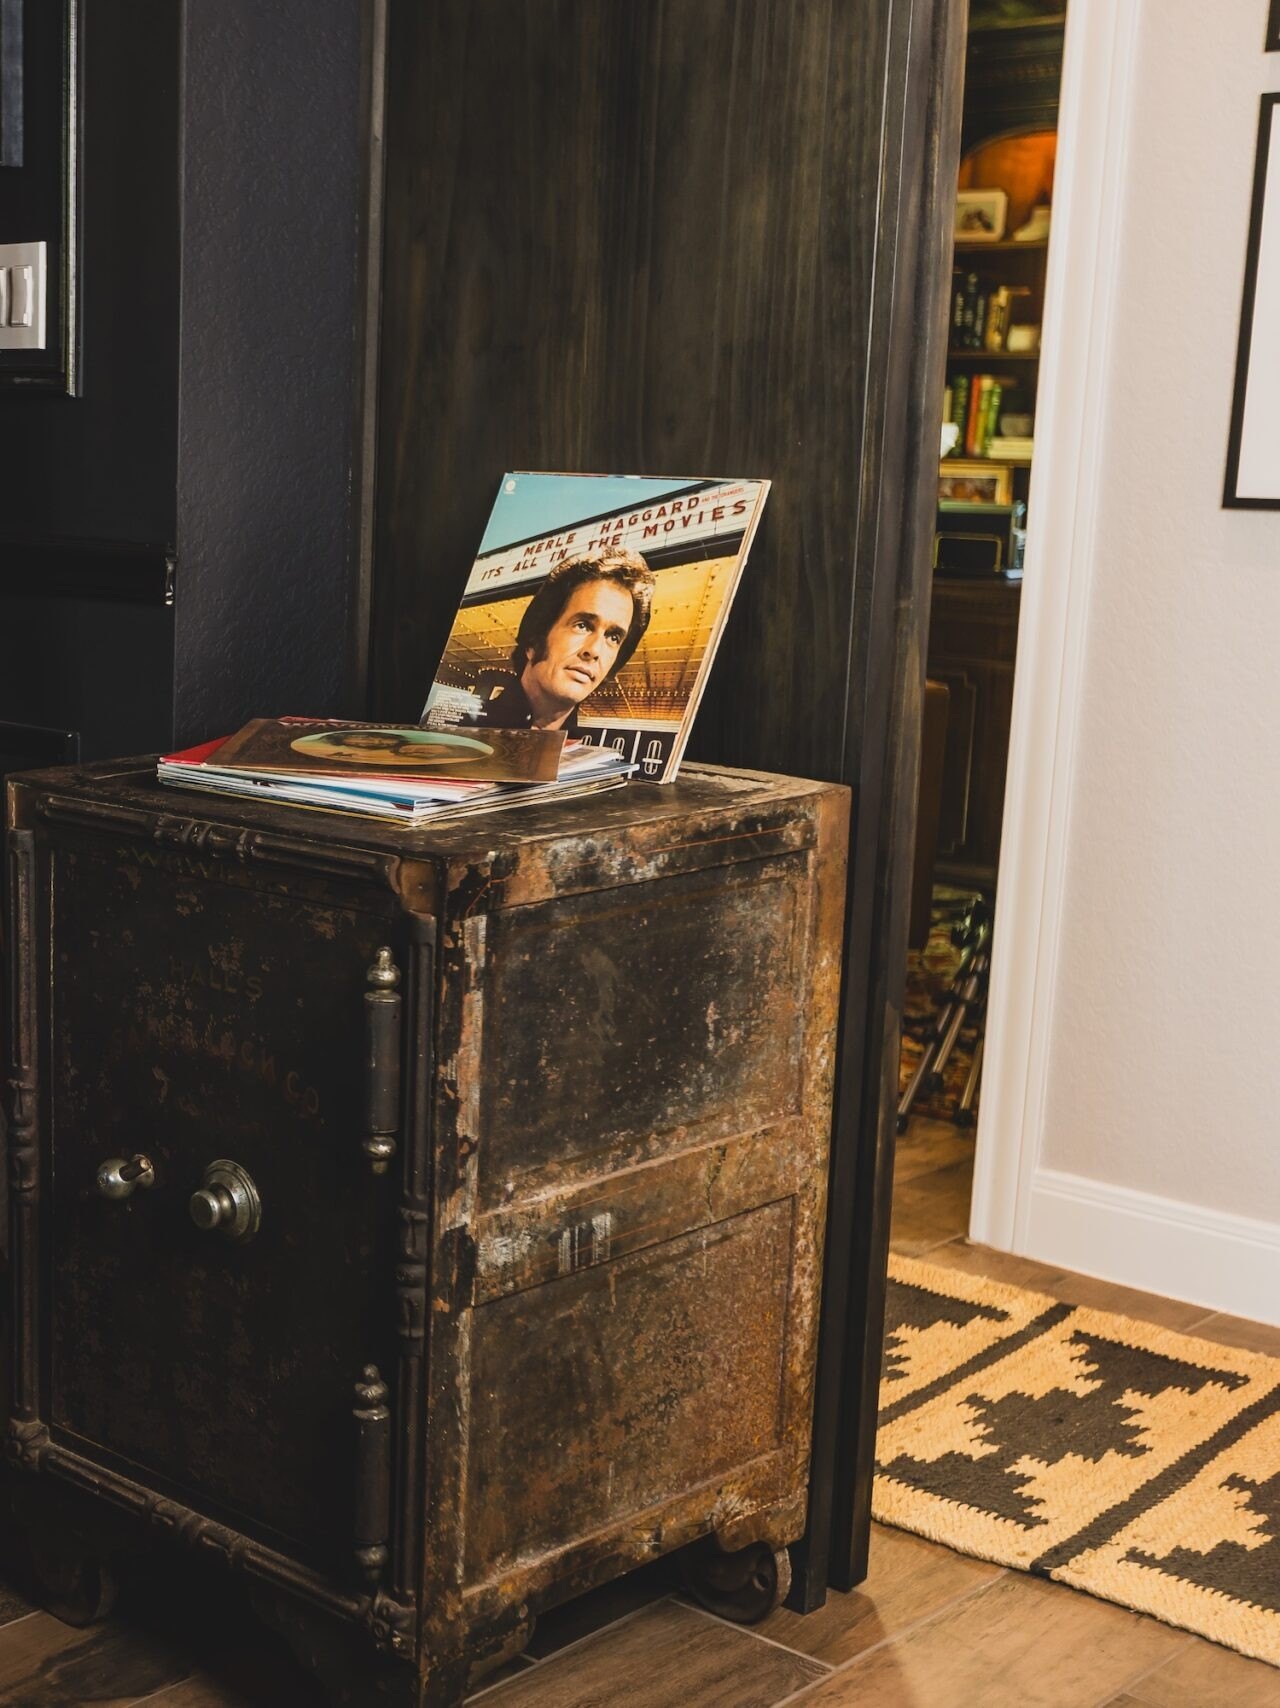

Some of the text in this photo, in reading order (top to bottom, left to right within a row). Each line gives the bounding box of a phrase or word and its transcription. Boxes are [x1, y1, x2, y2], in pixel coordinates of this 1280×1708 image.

[481, 499, 747, 581] ITS ALL IN THE MOVIES
[523, 532, 577, 557] MERLE
[599, 496, 700, 534] HAGGARD
